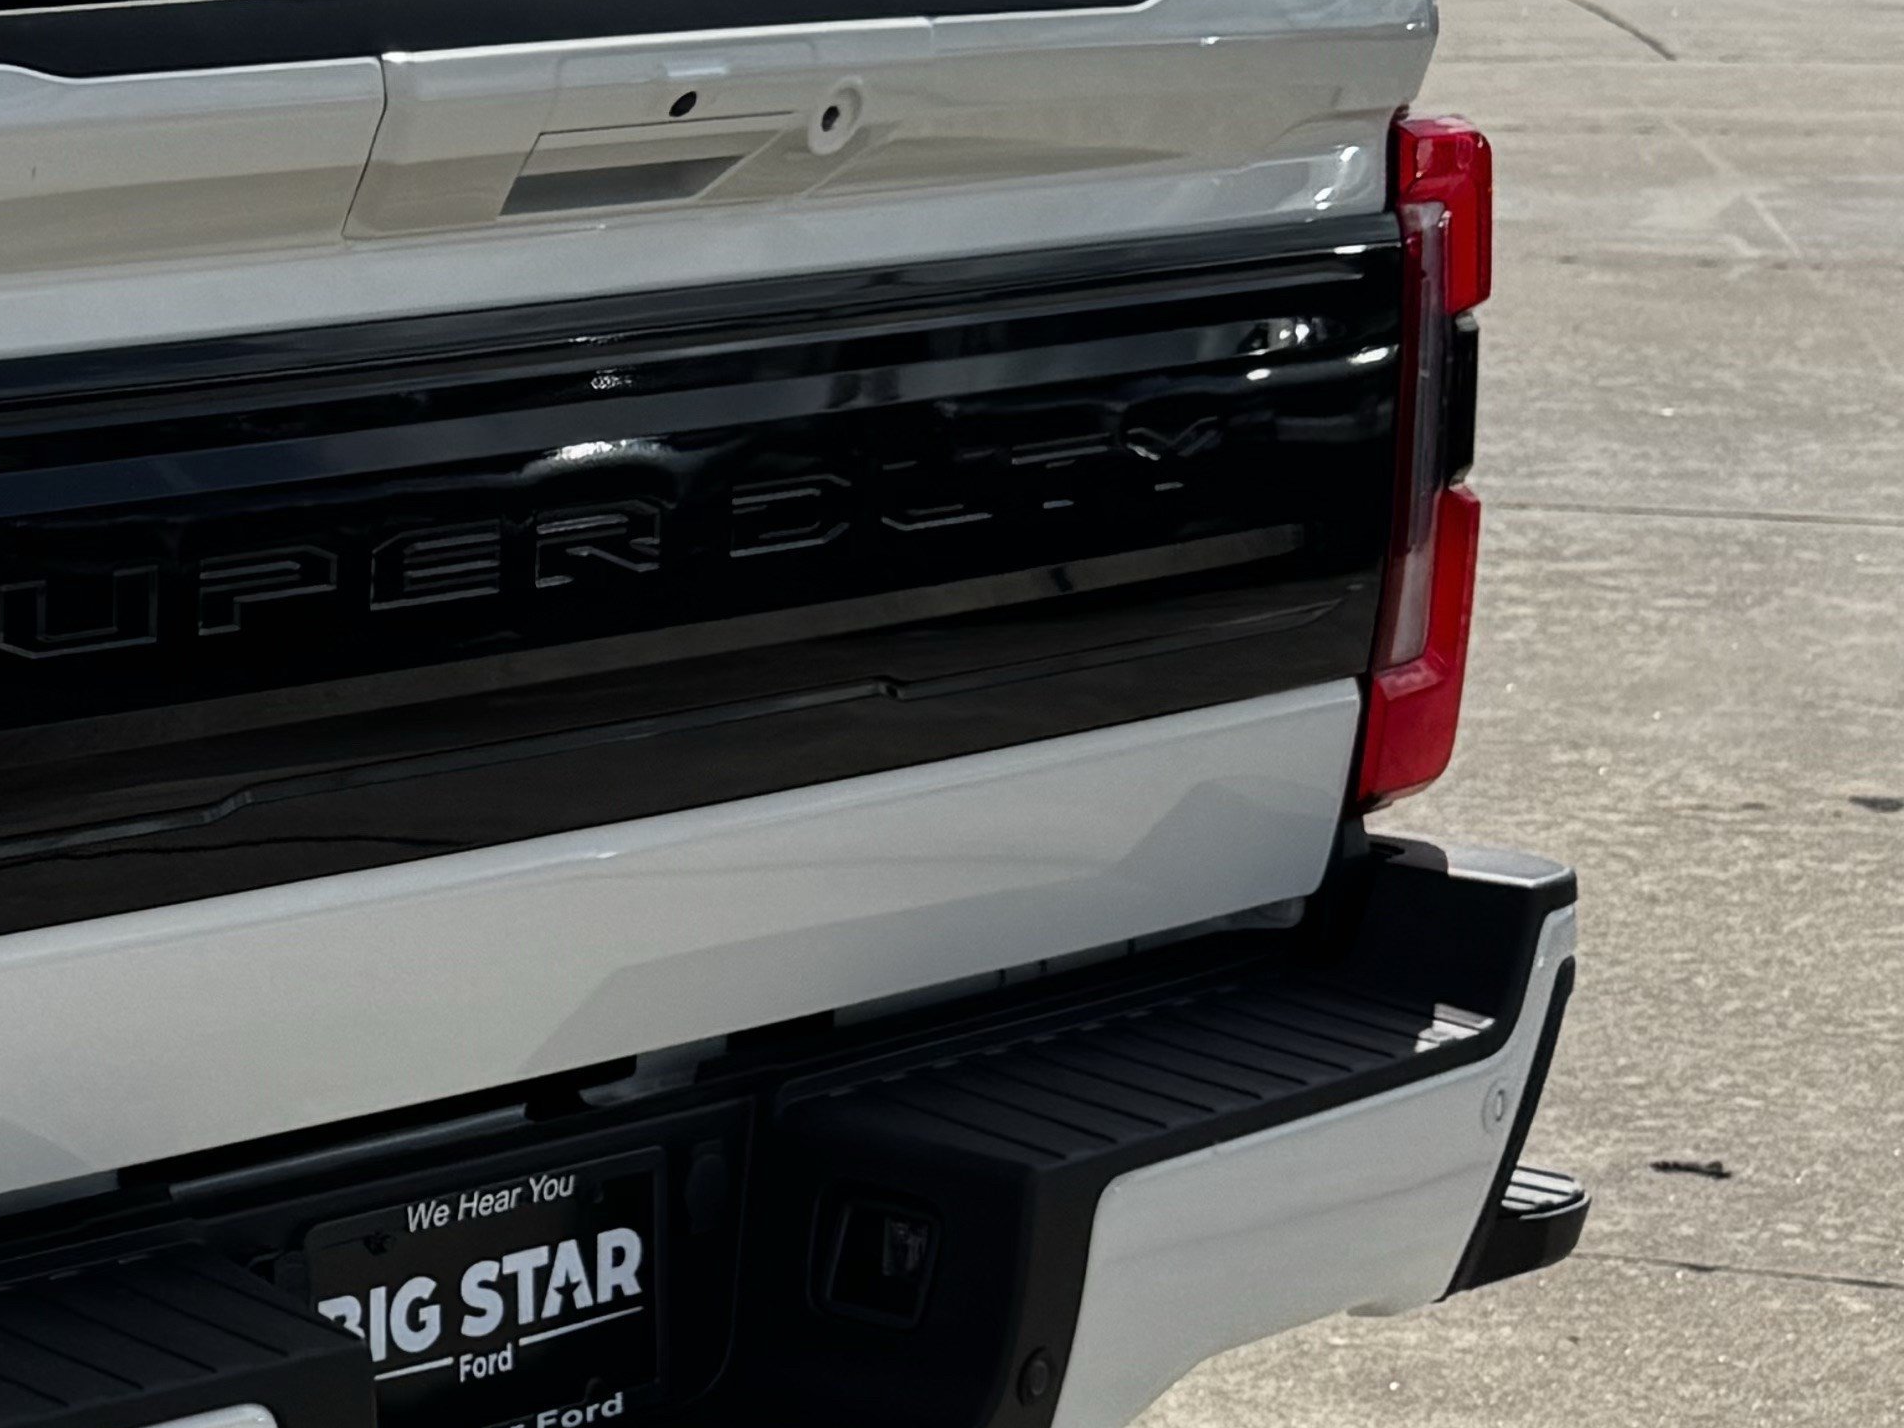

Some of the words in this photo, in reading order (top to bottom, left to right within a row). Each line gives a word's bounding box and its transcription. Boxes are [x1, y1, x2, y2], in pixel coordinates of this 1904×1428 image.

[730, 415, 1222, 558] DUTY
[406, 1199, 449, 1233] We
[457, 1184, 521, 1222] Hear
[529, 1174, 575, 1203] You
[460, 1227, 643, 1338] STAR
[458, 1343, 513, 1383] Ford
